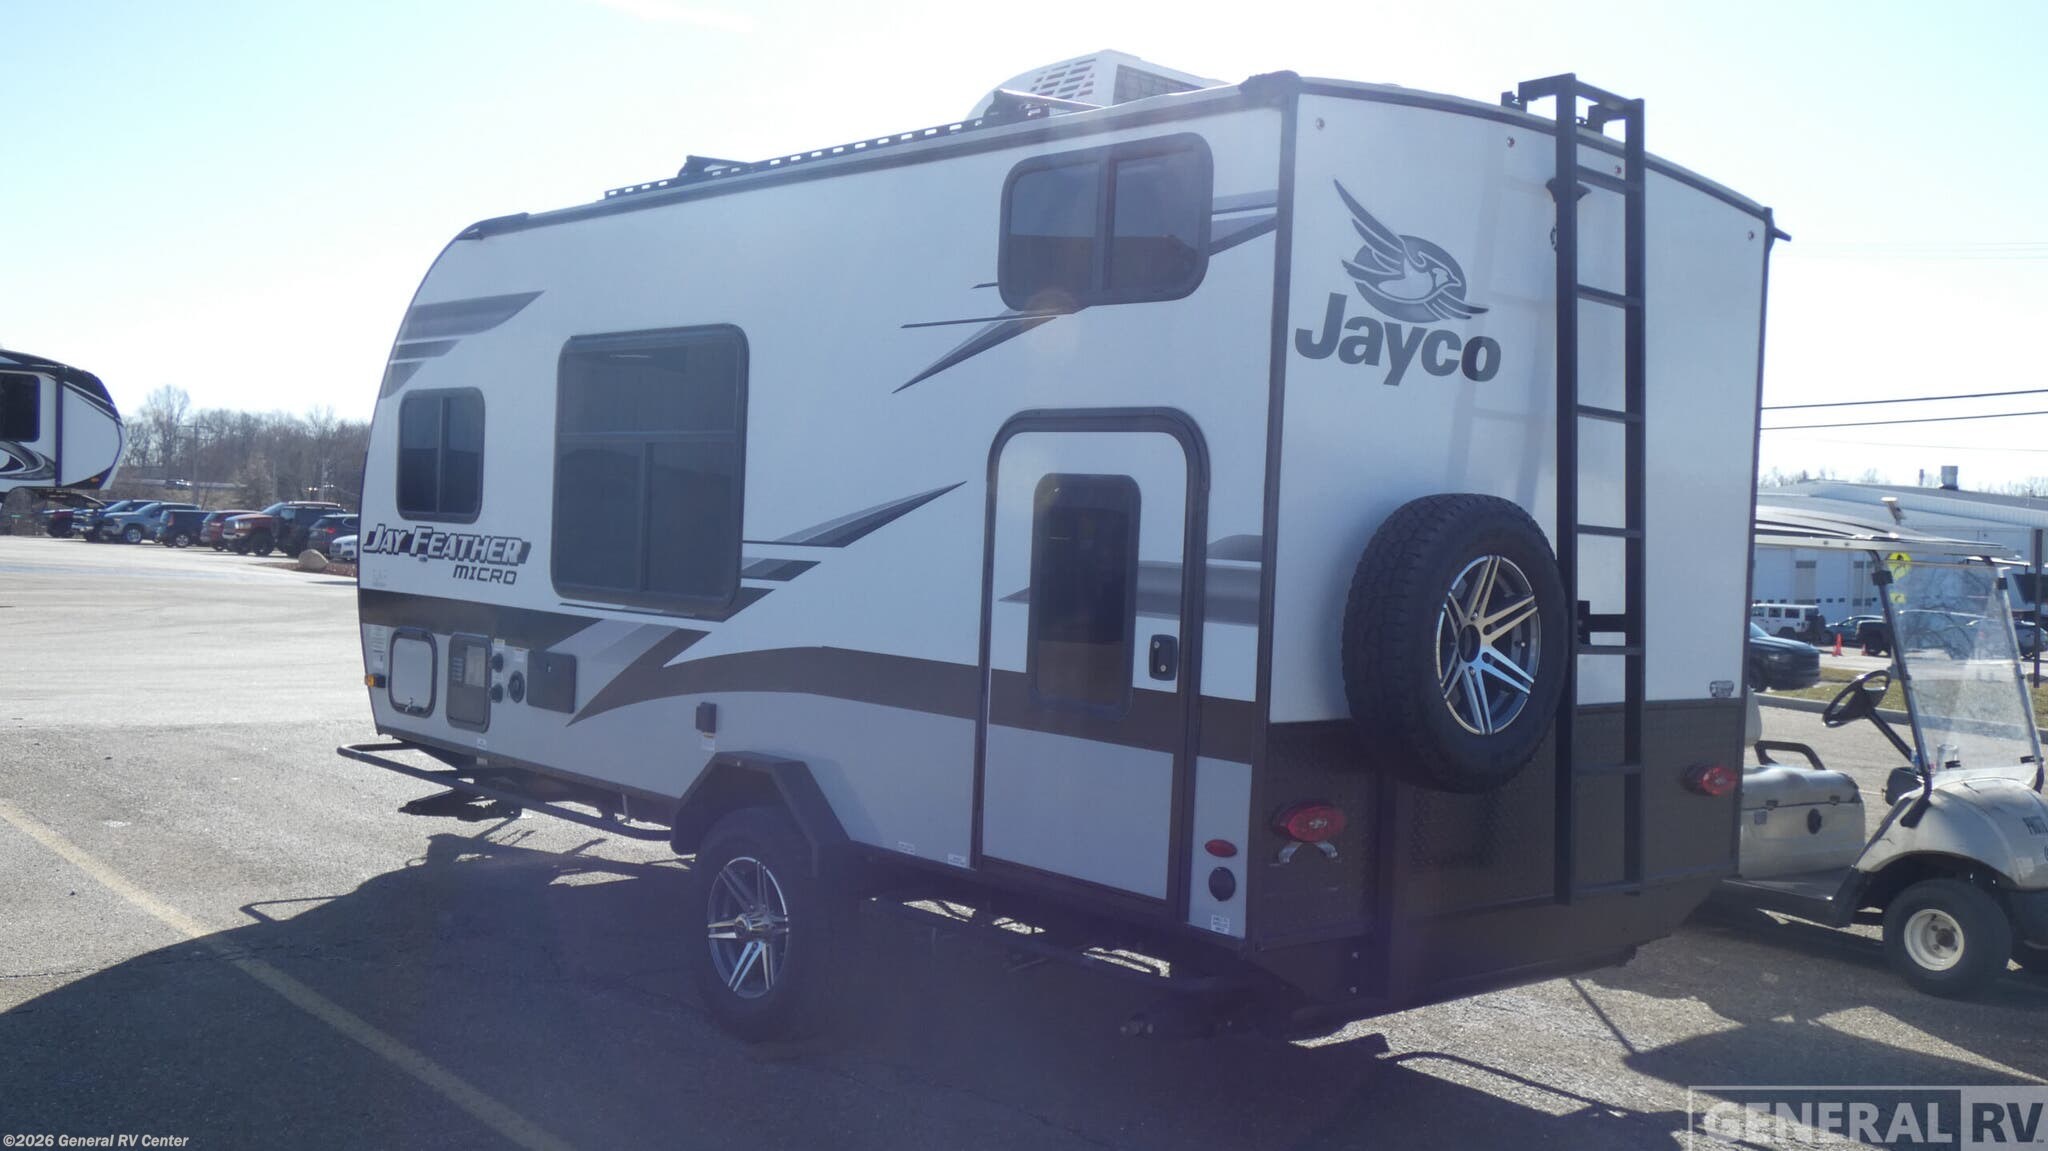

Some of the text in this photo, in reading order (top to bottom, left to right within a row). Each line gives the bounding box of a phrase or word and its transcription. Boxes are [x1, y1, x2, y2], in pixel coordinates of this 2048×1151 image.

[1294, 292, 1502, 386] Jayco
[363, 523, 524, 567] JAY FEATHER
[452, 565, 518, 585] MICRO
